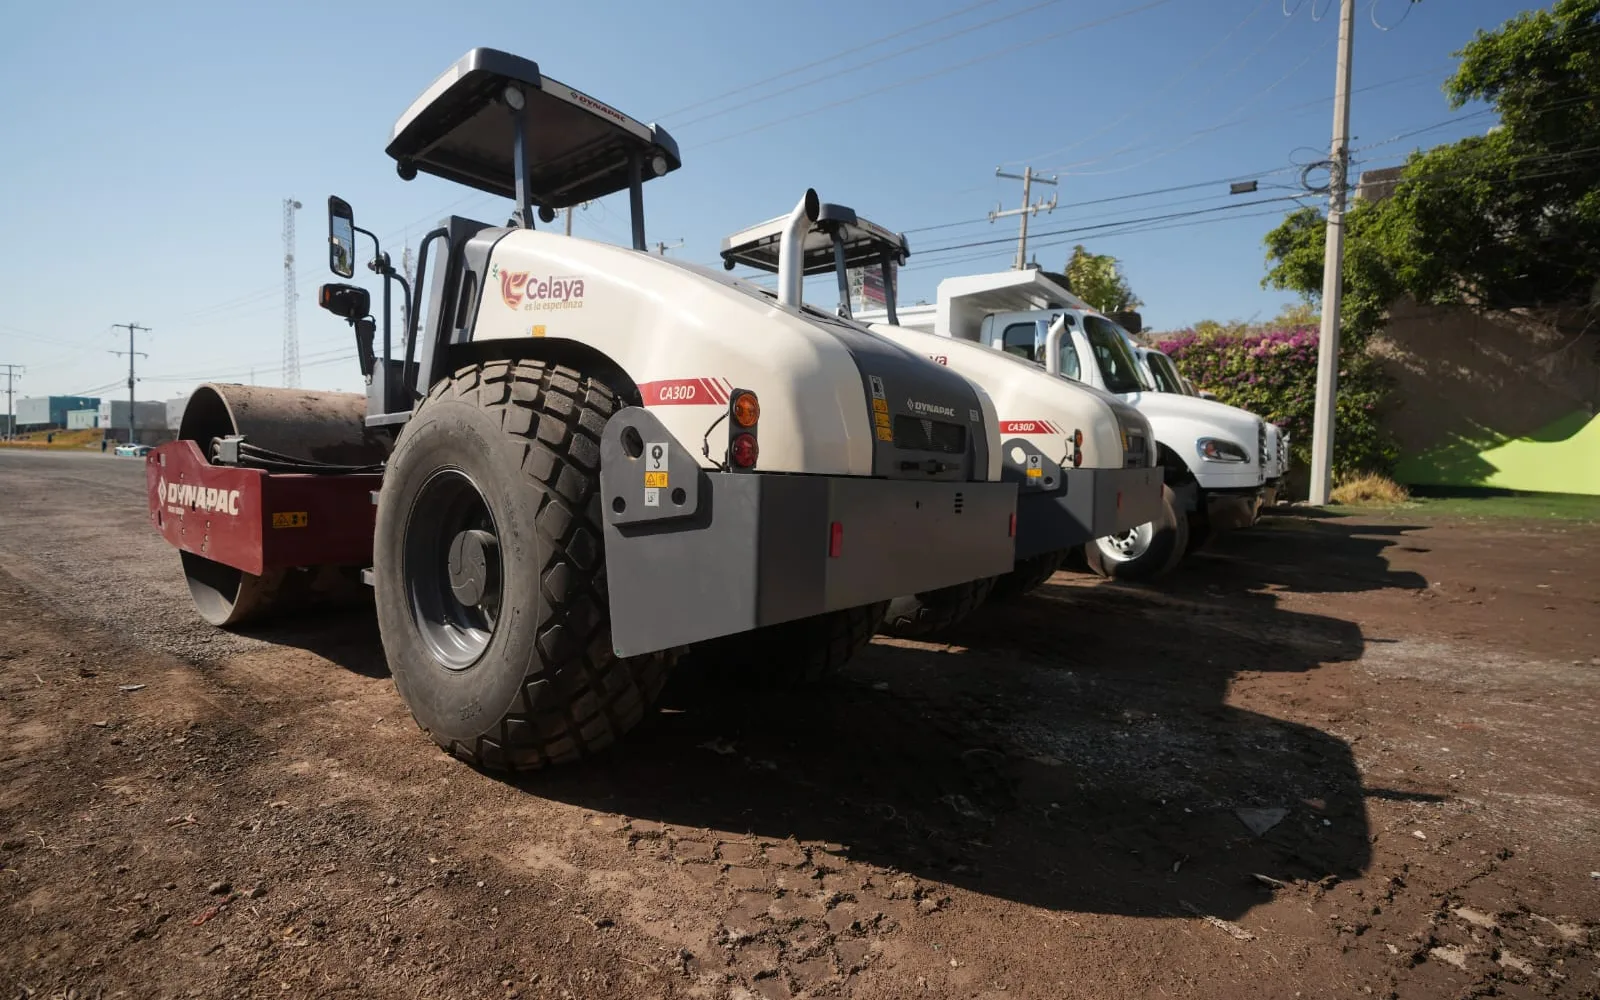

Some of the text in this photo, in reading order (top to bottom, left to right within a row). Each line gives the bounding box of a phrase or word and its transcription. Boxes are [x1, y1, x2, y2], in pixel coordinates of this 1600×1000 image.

[579, 95, 626, 122] DYNAPAC
[526, 276, 584, 301] Celaya
[525, 301, 583, 311] es la esperanza
[659, 385, 696, 400] CA30D
[915, 402, 955, 417] DYNAPAC
[1007, 423, 1035, 431] CA30D
[167, 482, 240, 516] DYNAPAC
